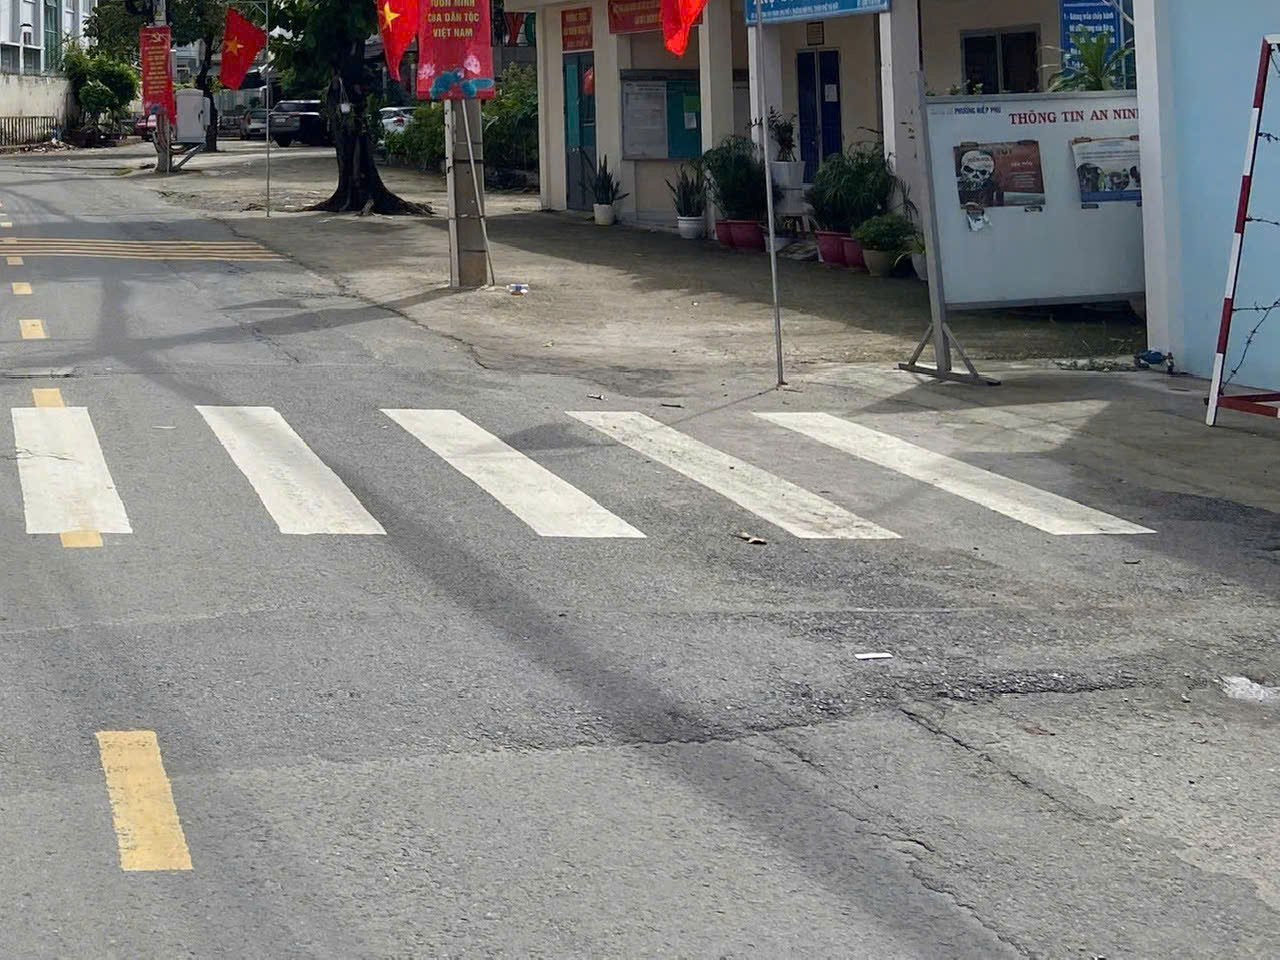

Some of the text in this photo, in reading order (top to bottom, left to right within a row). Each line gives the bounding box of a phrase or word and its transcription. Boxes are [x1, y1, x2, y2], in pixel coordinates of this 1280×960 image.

[1009, 109, 1057, 124] THÔNG
[1061, 110, 1084, 122] TIN
[1090, 109, 1108, 121] AN
